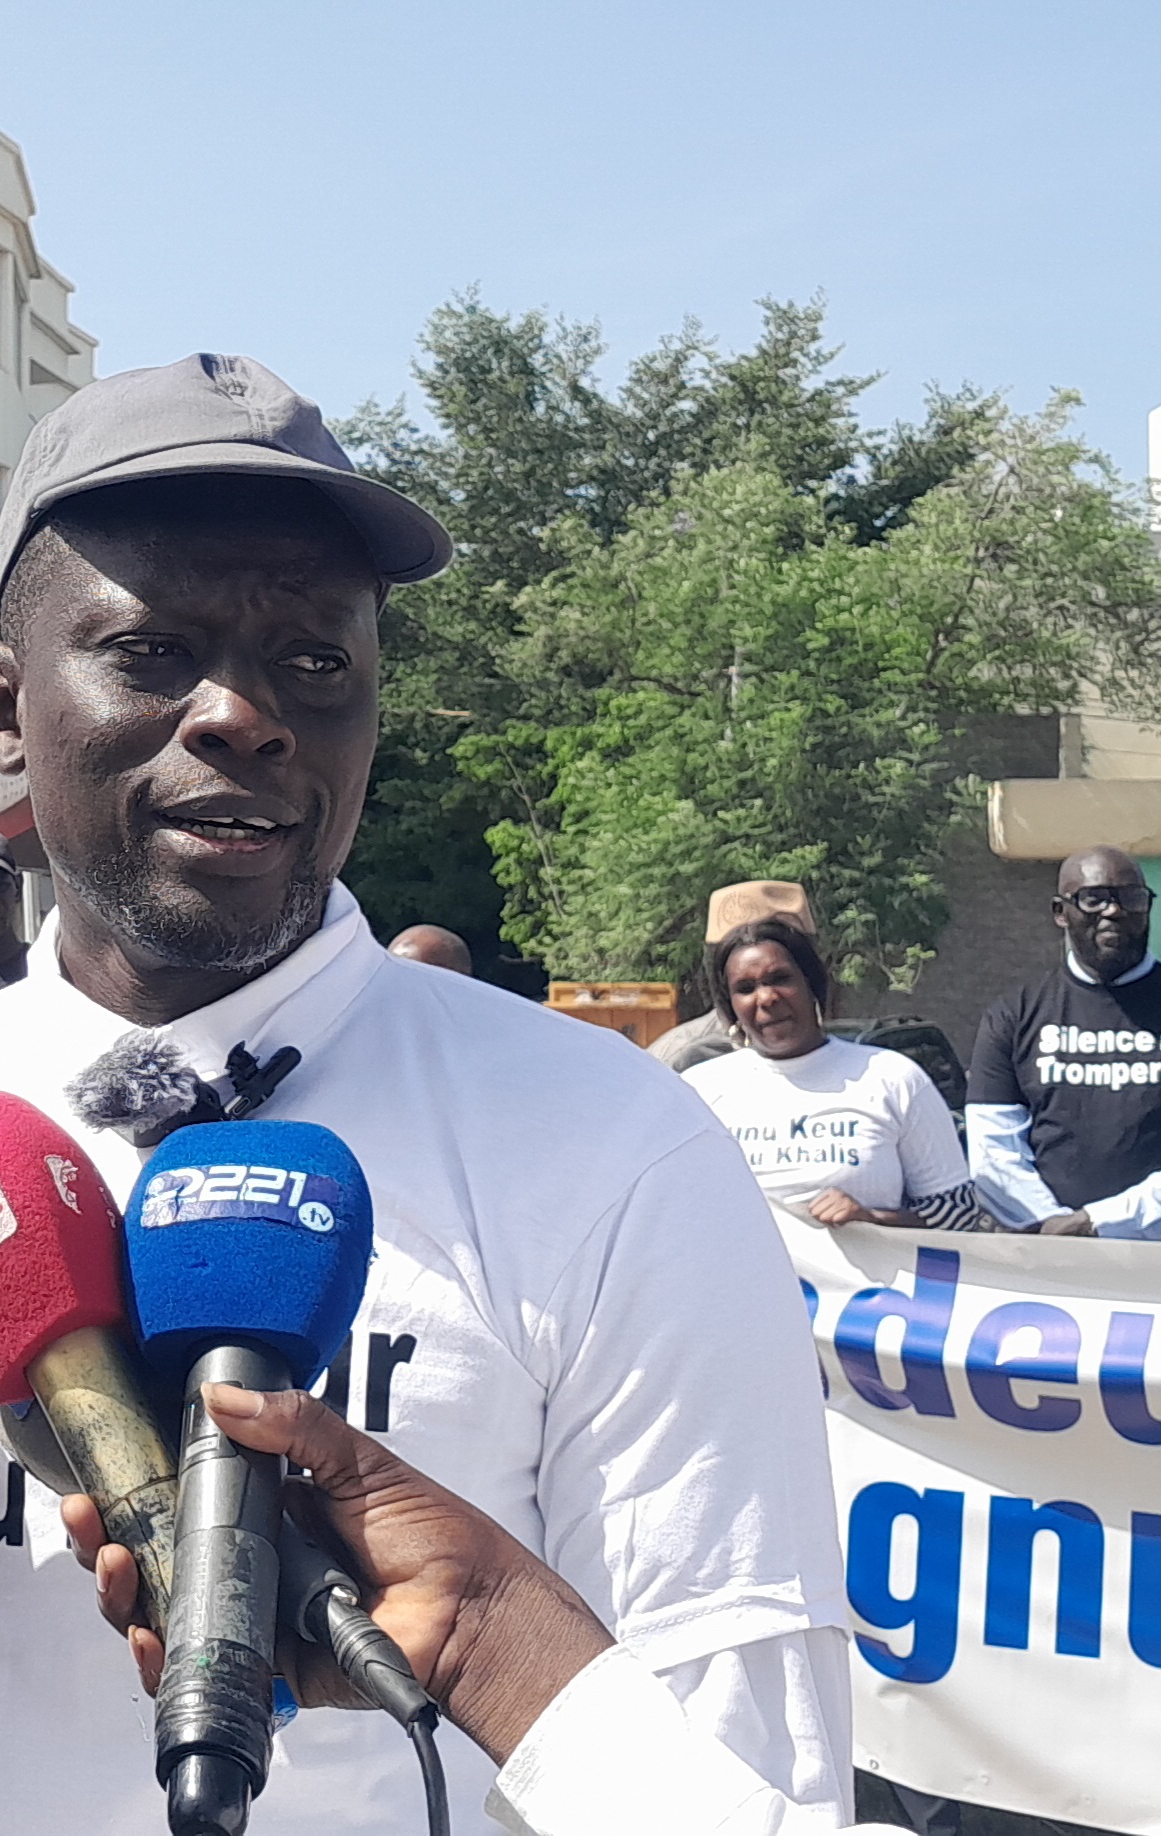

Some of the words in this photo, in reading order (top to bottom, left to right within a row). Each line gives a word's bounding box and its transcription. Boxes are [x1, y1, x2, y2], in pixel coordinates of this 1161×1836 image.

[1038, 1024, 1157, 1054] Silence
[728, 1126, 777, 1142] unu
[790, 1114, 860, 1140] Keur
[776, 1143, 860, 1167] Khalis
